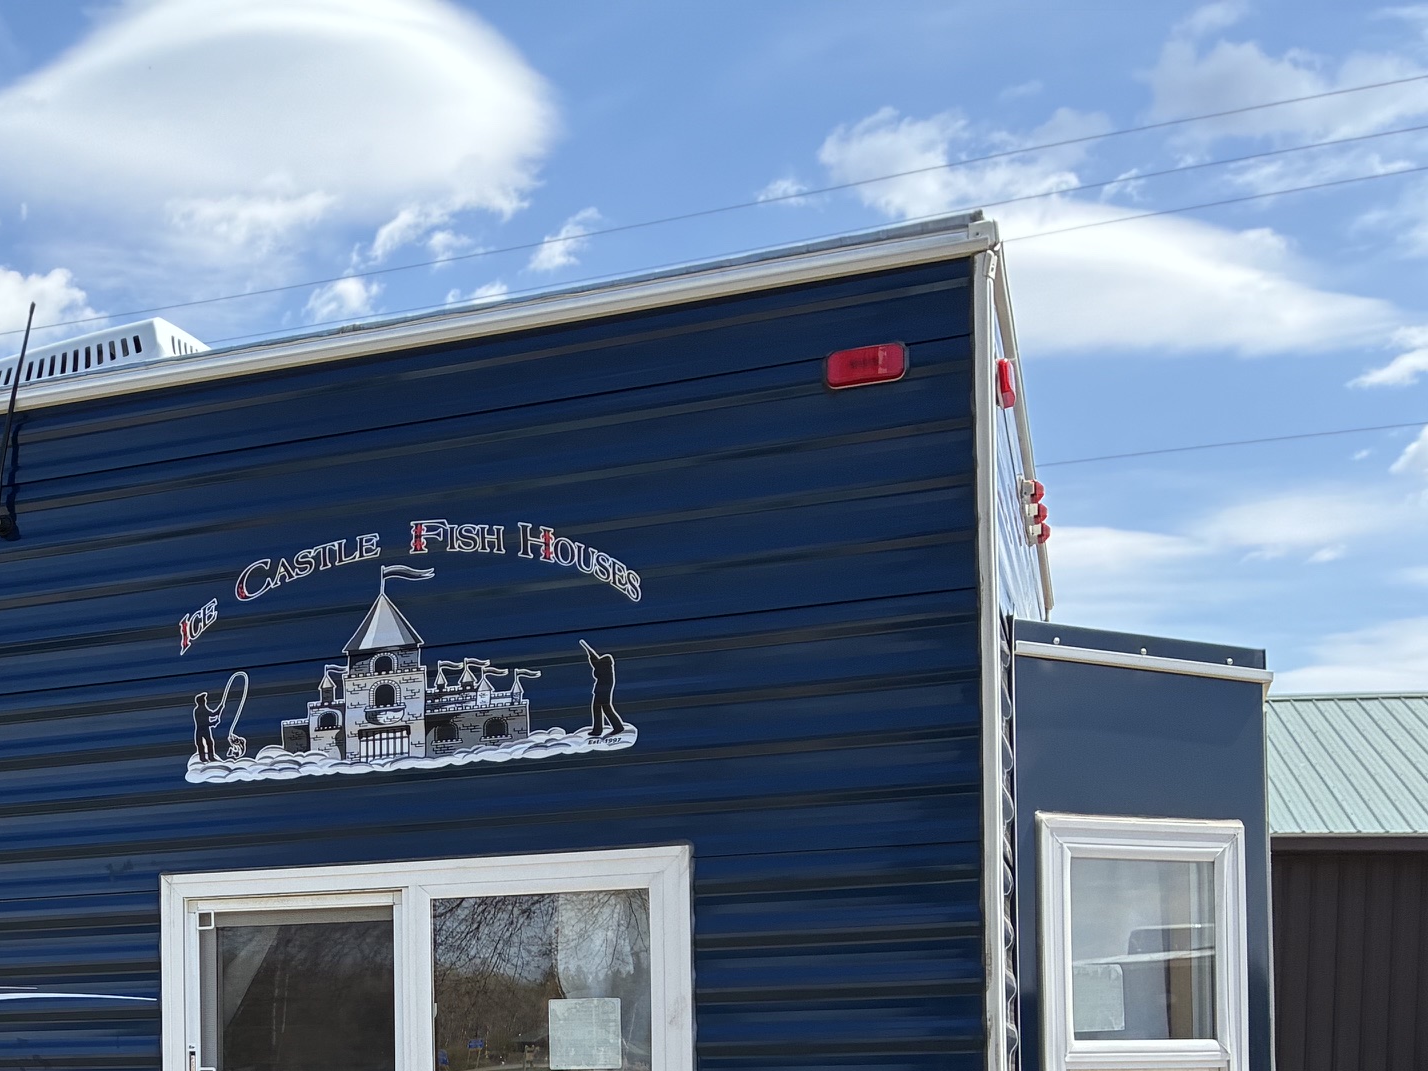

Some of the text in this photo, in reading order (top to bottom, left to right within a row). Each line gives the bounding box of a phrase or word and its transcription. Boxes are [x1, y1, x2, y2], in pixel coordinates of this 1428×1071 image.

[179, 519, 643, 655] ICE CASTLE FISH HOUSES
